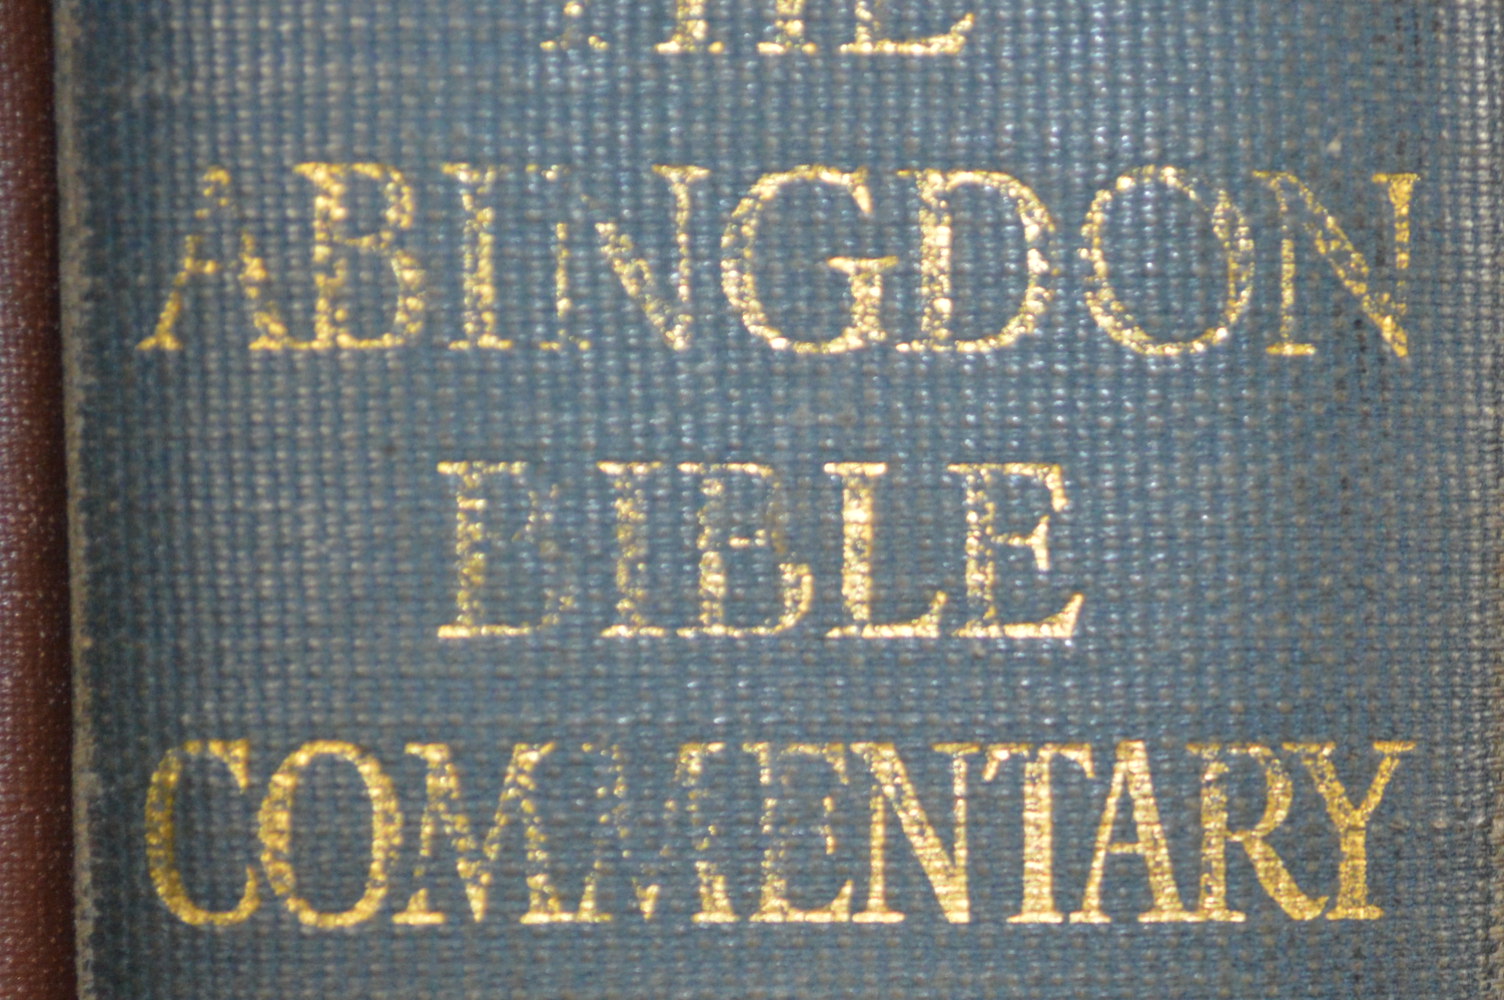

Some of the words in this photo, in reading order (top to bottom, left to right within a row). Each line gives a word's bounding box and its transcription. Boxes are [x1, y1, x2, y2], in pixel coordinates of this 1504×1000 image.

[135, 161, 1421, 356] ABINGDON
[436, 460, 1084, 640] BIBLE
[144, 738, 1417, 930] COMMENTARY
